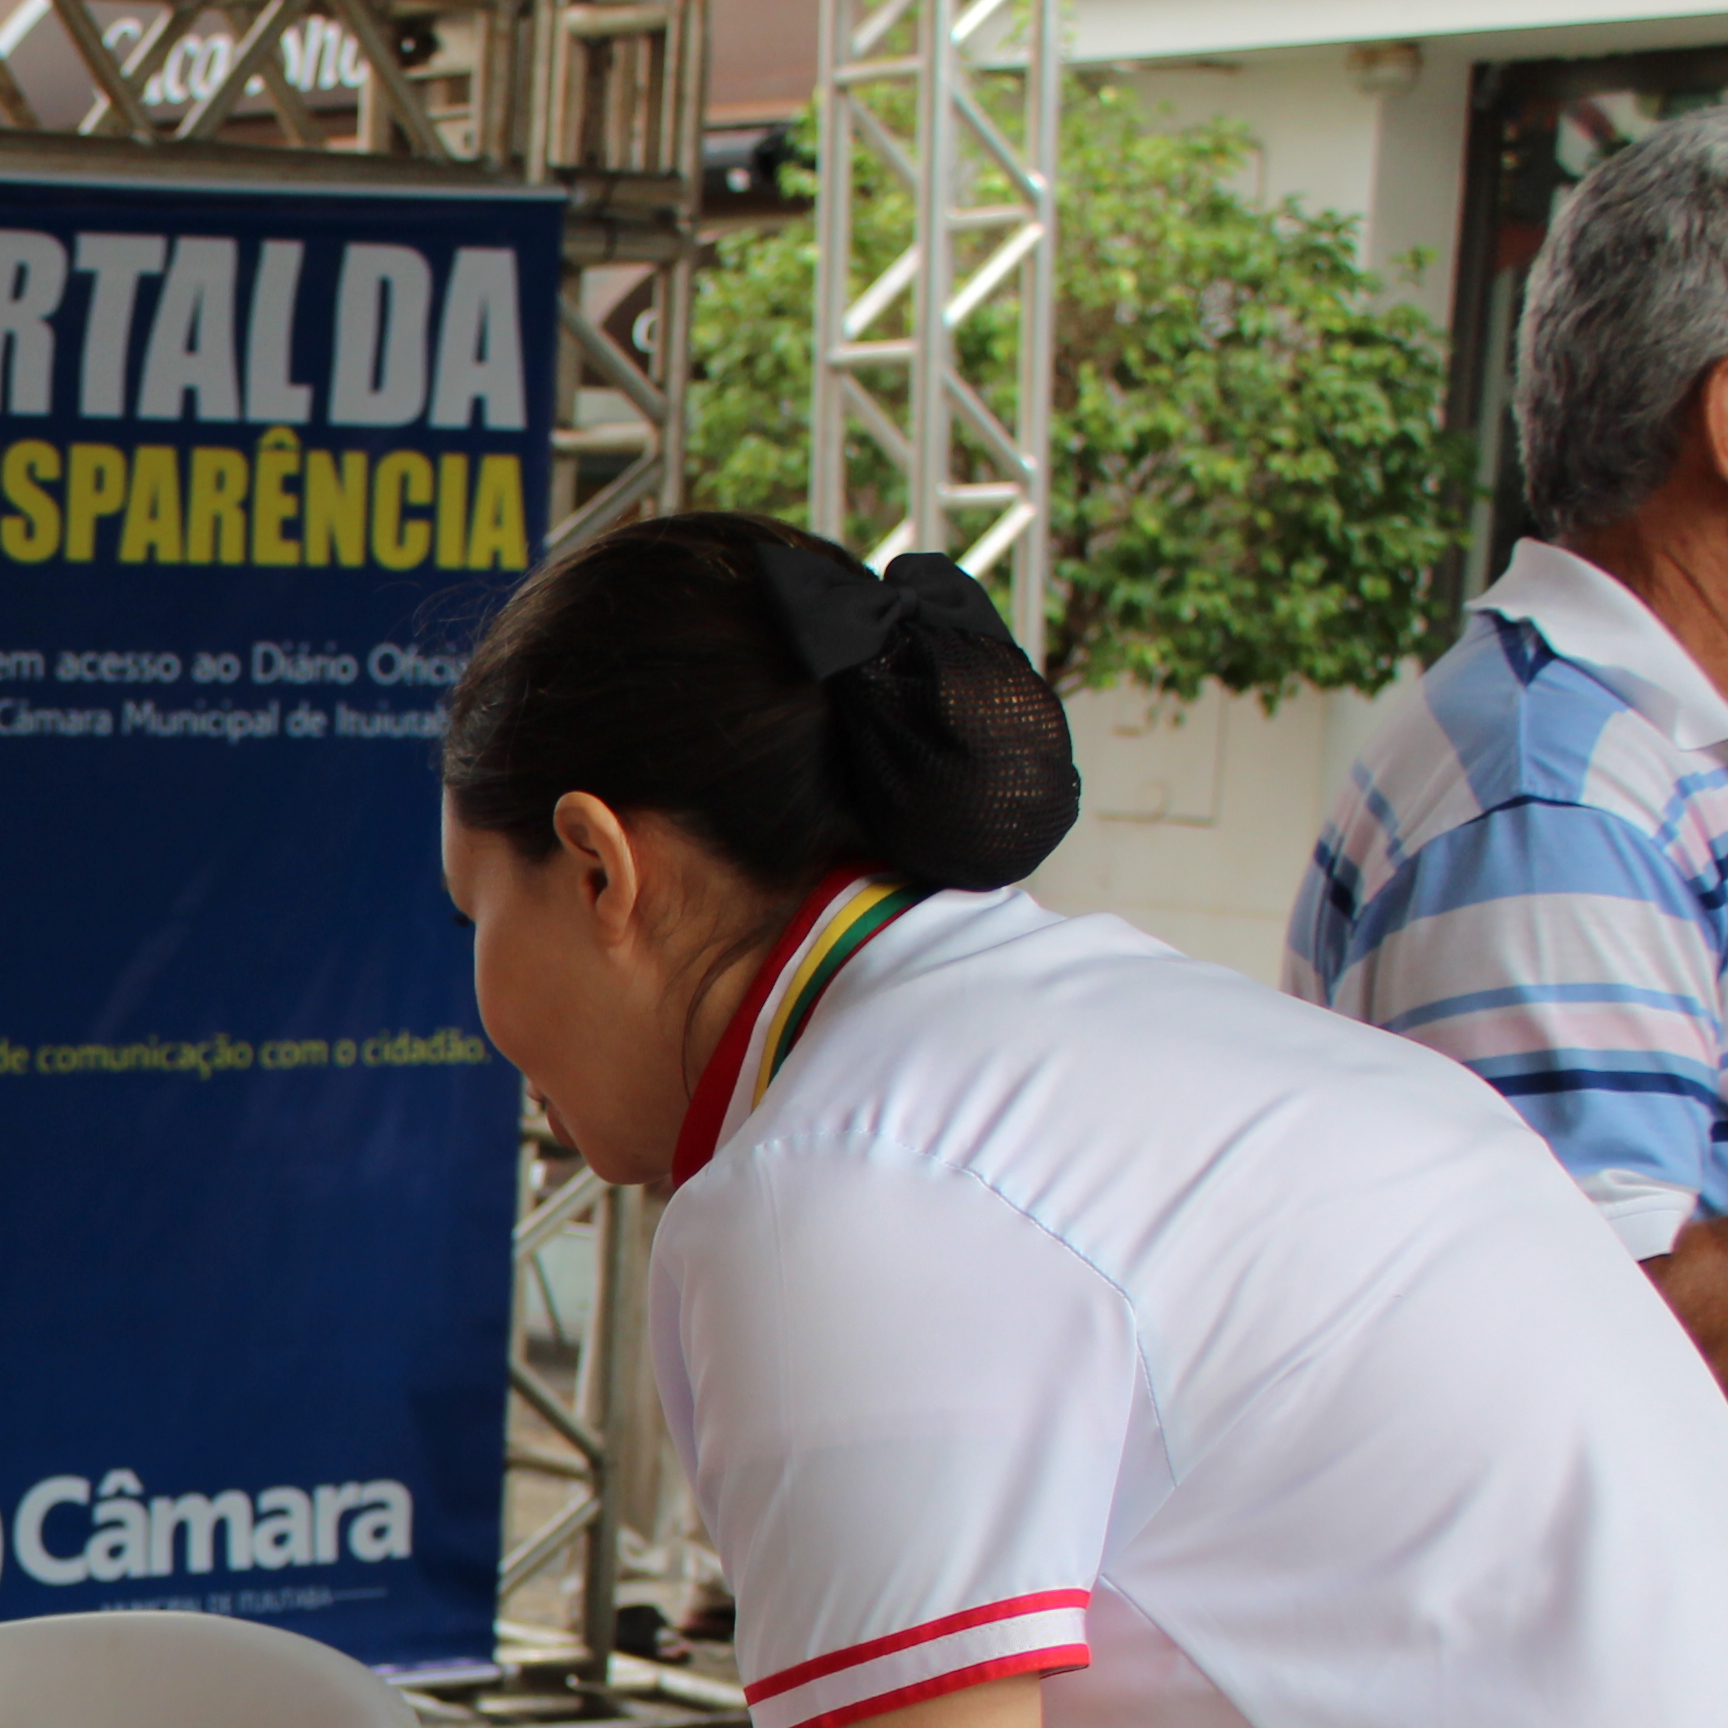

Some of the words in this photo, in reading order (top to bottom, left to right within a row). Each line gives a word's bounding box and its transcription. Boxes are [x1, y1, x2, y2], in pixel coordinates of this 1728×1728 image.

[327, 243, 528, 430] DA
[56, 649, 181, 684] acesso
[191, 651, 241, 684] ao
[253, 641, 359, 685] Diário
[122, 698, 279, 745] Municipal
[286, 701, 327, 739] de
[336, 700, 451, 740] Ituiutab
[36, 1032, 254, 1081] comunicação
[261, 1039, 328, 1069] com
[334, 1040, 357, 1068] o
[12, 1467, 413, 1587] Câmara
